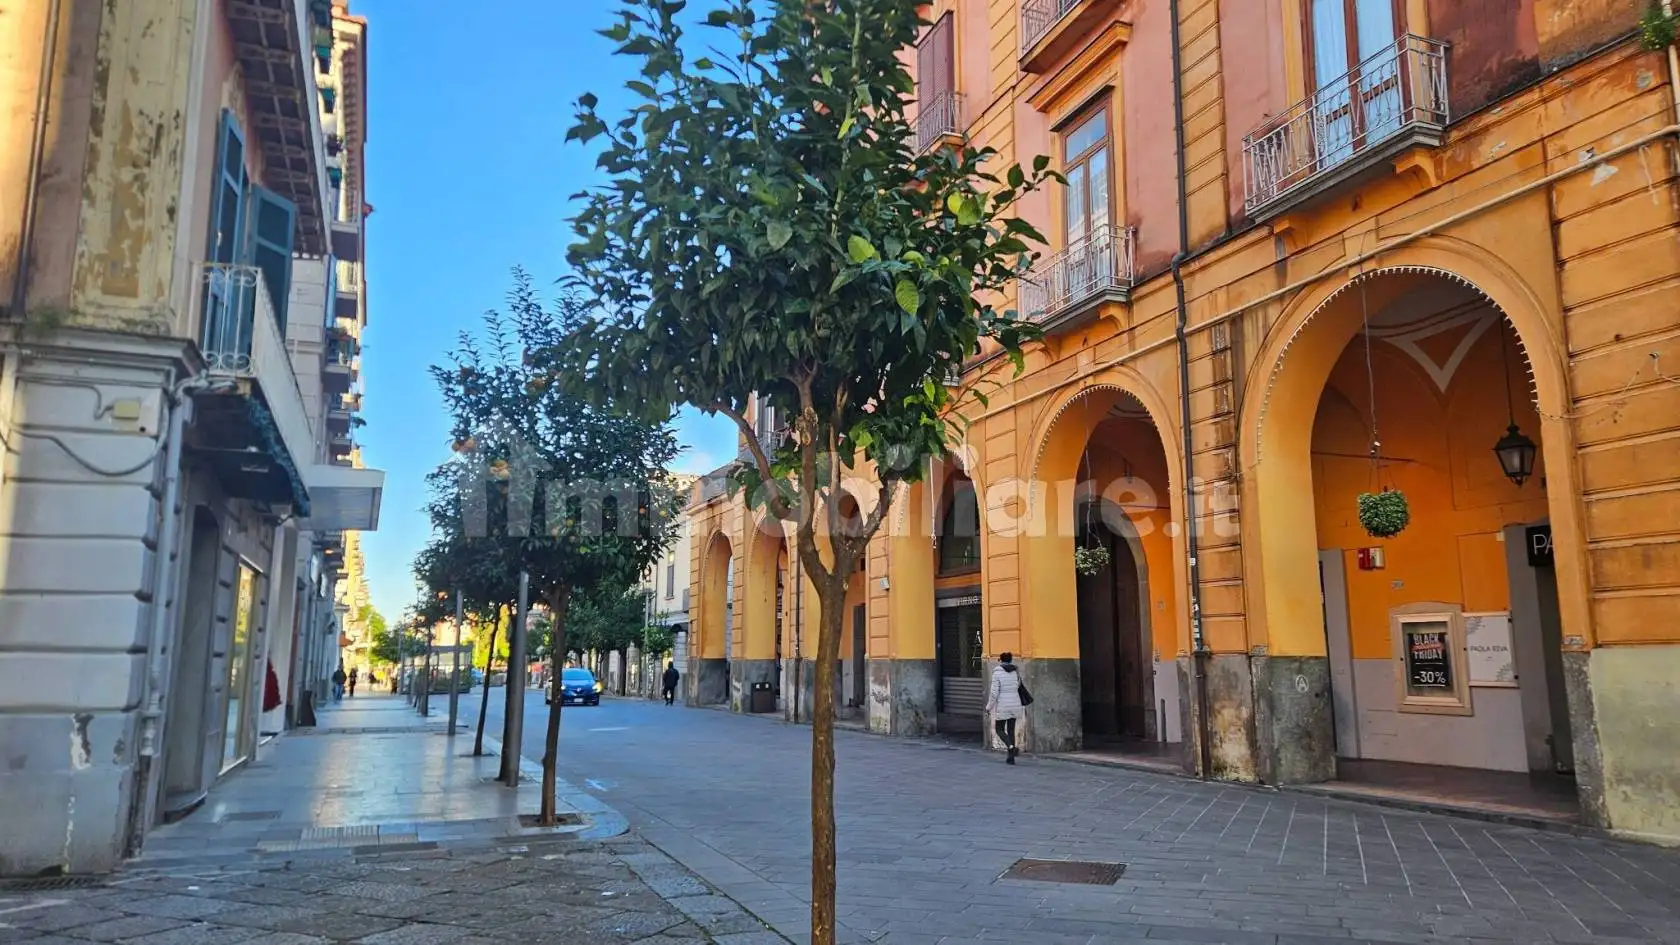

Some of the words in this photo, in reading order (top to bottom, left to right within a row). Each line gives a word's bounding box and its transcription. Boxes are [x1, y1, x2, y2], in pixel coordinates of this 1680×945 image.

[1413, 633, 1439, 645] BLACK
[1414, 649, 1443, 660] FRIDAY
[1413, 670, 1447, 684] -30%
